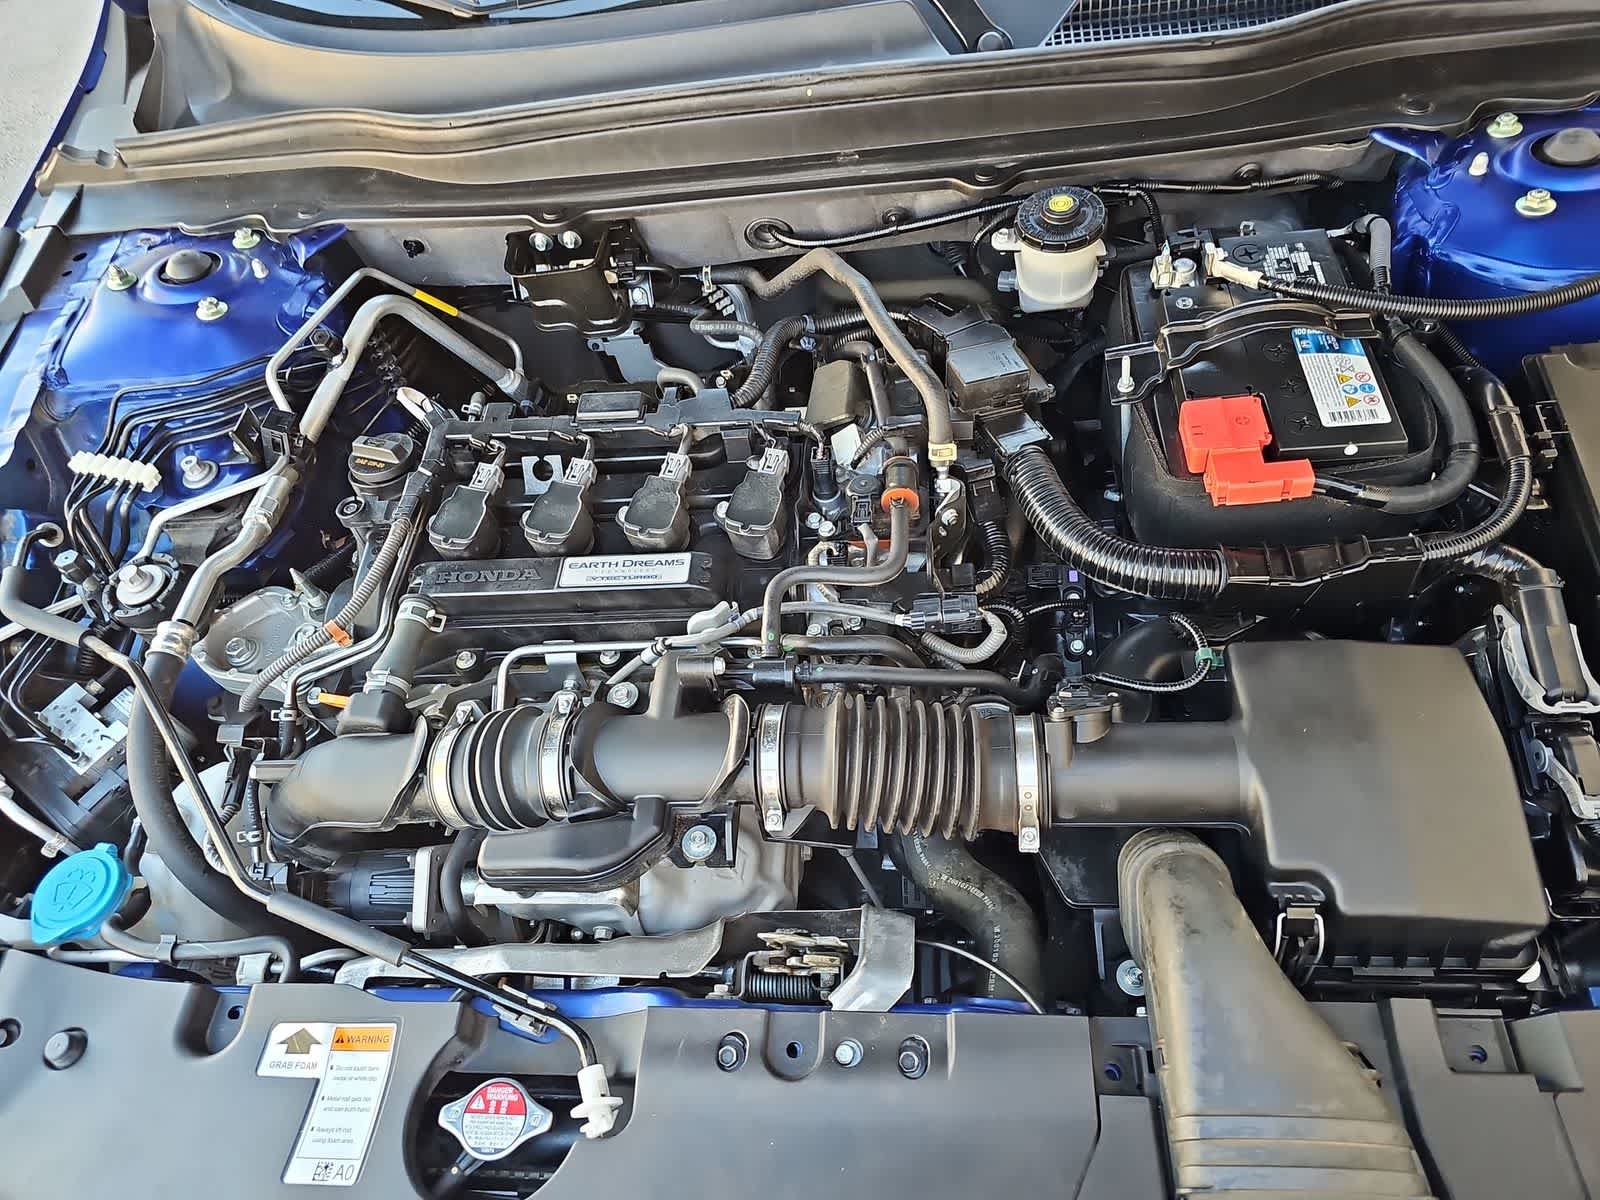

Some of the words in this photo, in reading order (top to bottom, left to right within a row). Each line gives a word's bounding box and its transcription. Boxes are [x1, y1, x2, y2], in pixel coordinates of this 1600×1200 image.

[568, 561, 619, 570] EARTH
[622, 559, 686, 568] DREAMS
[435, 568, 543, 584] HONDA
[346, 1034, 390, 1044] WARNING
[269, 1061, 294, 1070] GRAB
[295, 1061, 319, 1071] FOAM
